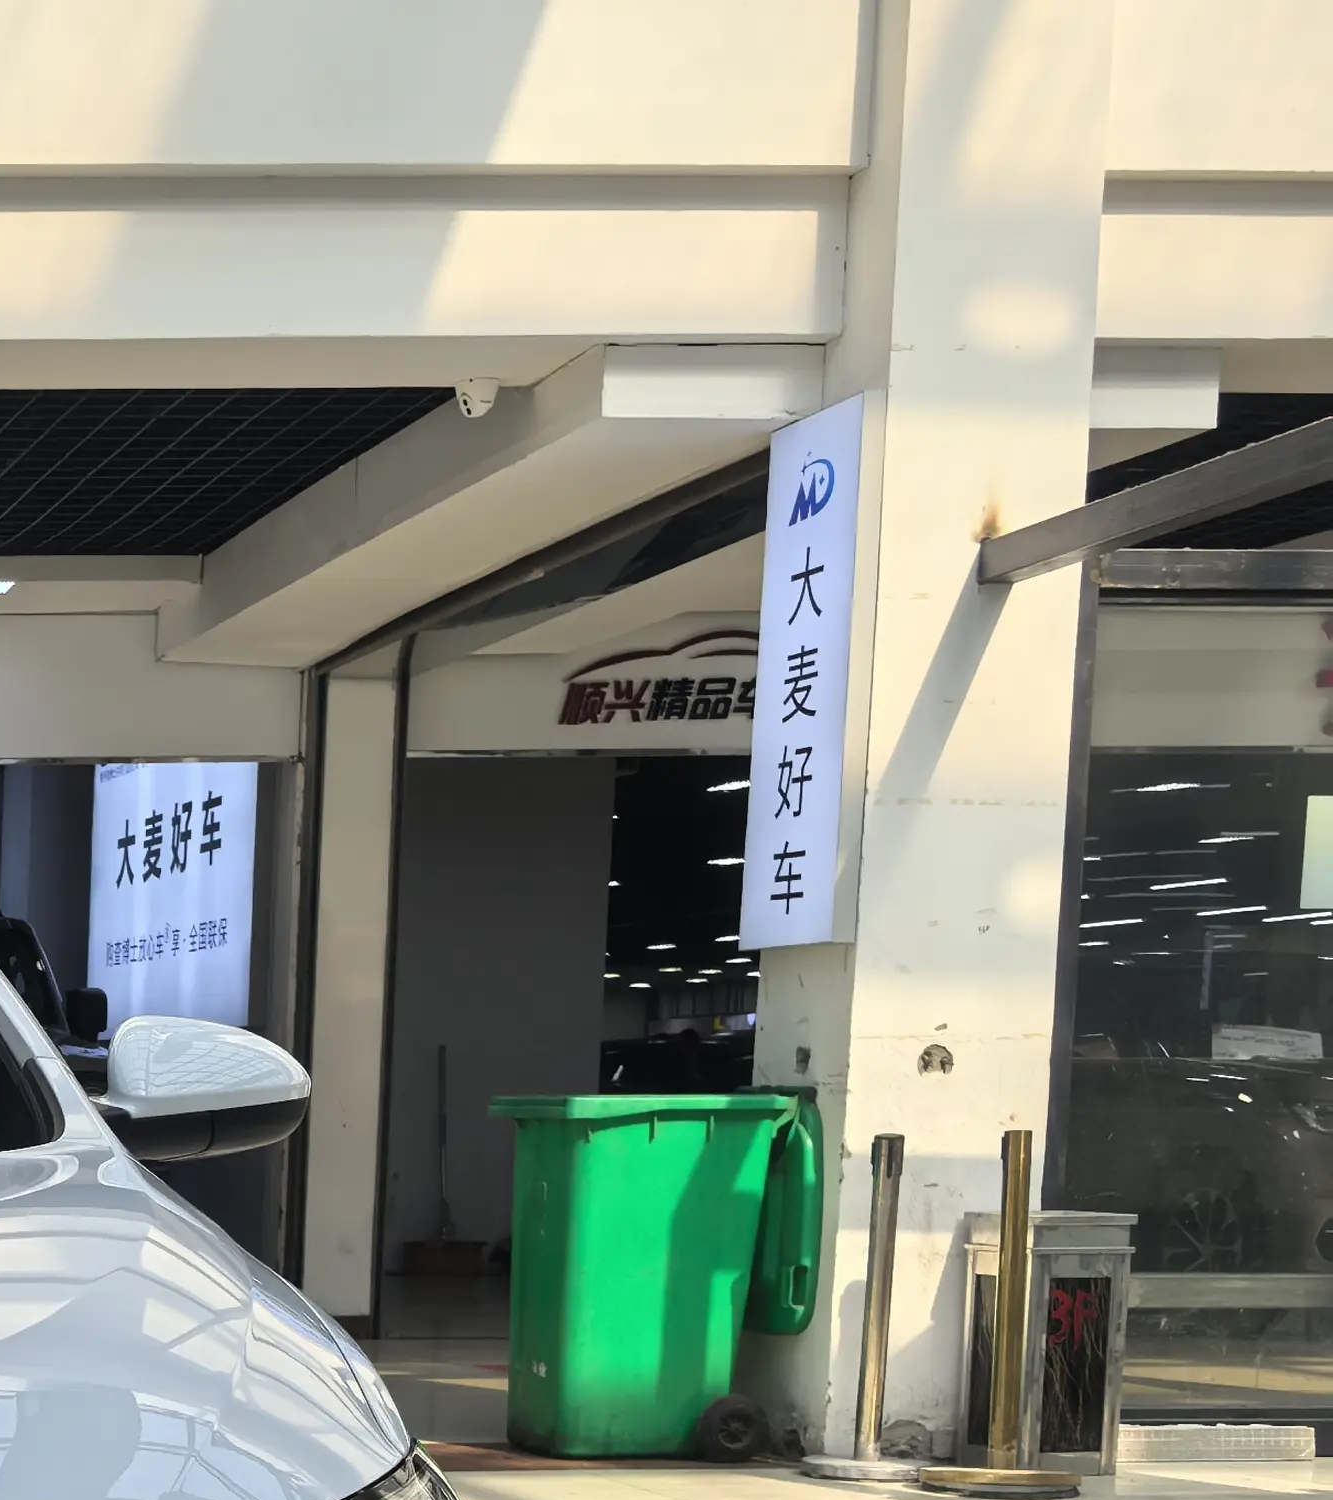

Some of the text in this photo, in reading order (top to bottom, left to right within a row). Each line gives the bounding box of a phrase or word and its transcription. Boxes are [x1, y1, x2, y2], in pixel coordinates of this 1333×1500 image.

[116, 791, 224, 888] 大麦好车
[770, 547, 823, 915] 大麦好车
